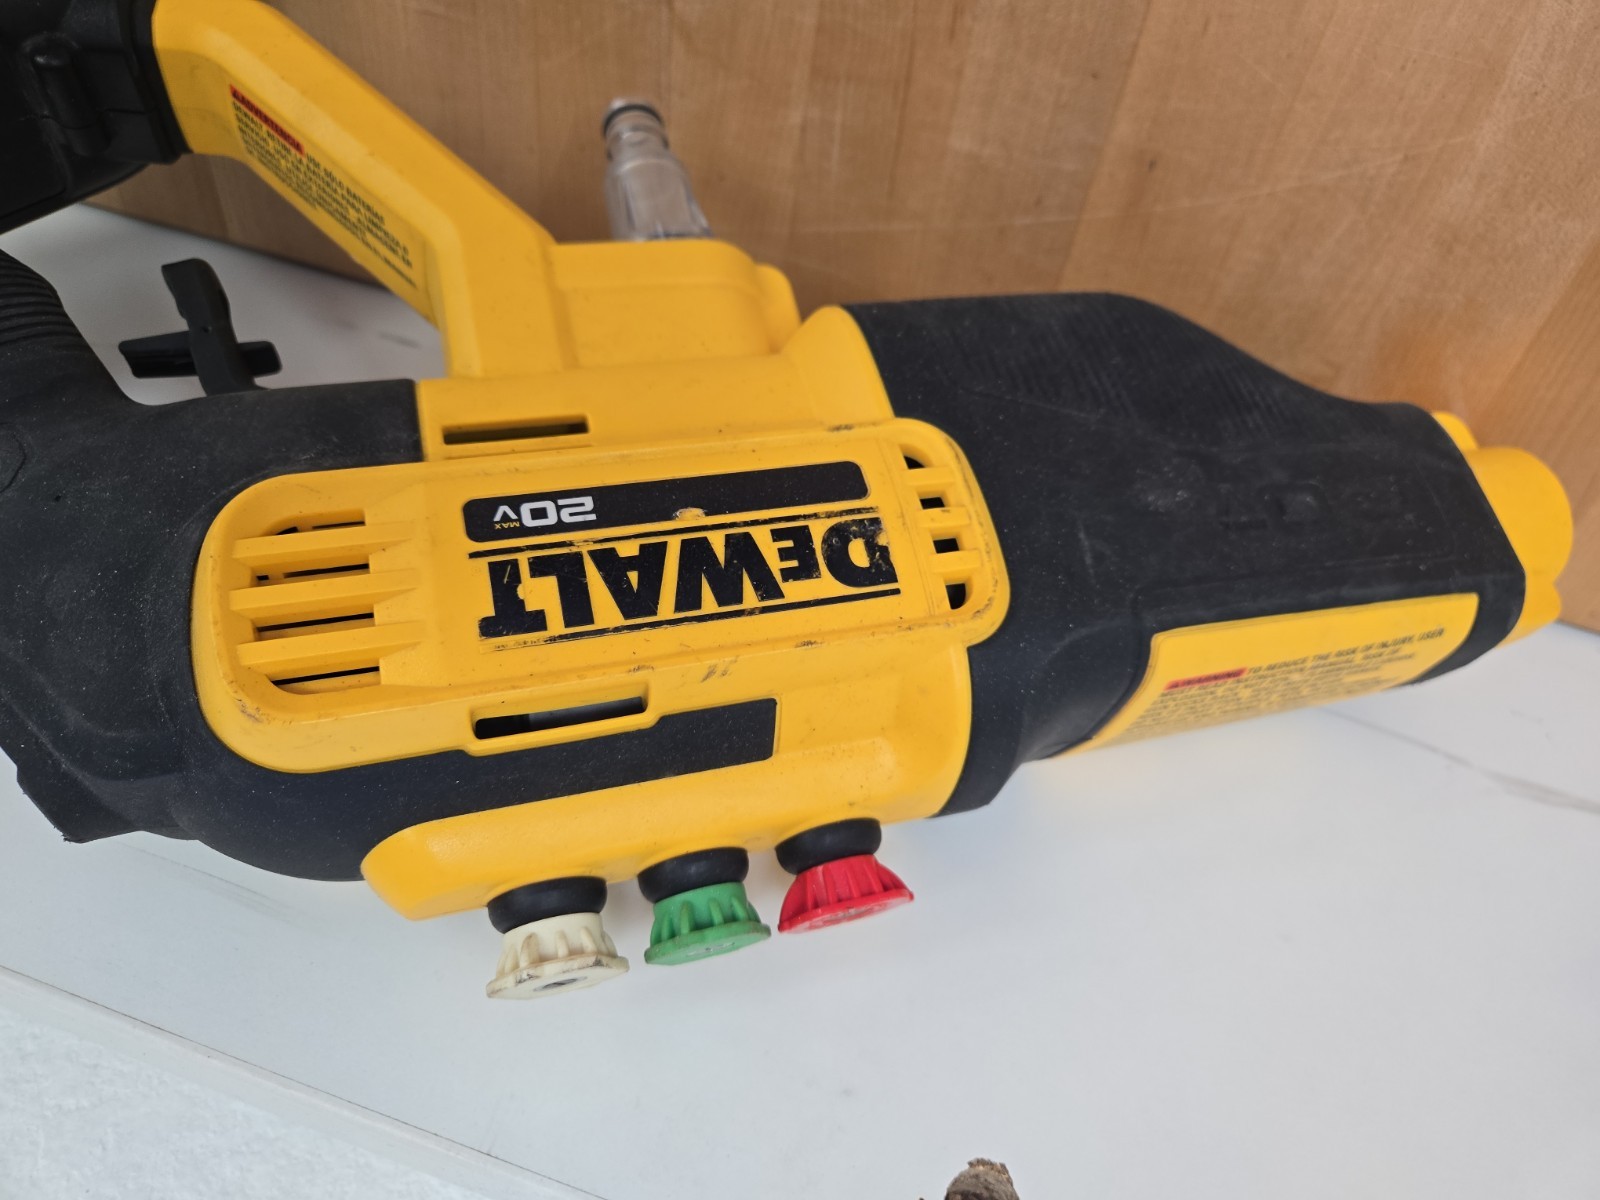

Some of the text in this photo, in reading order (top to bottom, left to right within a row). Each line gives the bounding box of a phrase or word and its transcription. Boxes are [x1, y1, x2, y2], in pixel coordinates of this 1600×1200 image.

[494, 521, 520, 530] MAX
[1181, 668, 1244, 687] WARNING
[1417, 626, 1445, 642] USER
